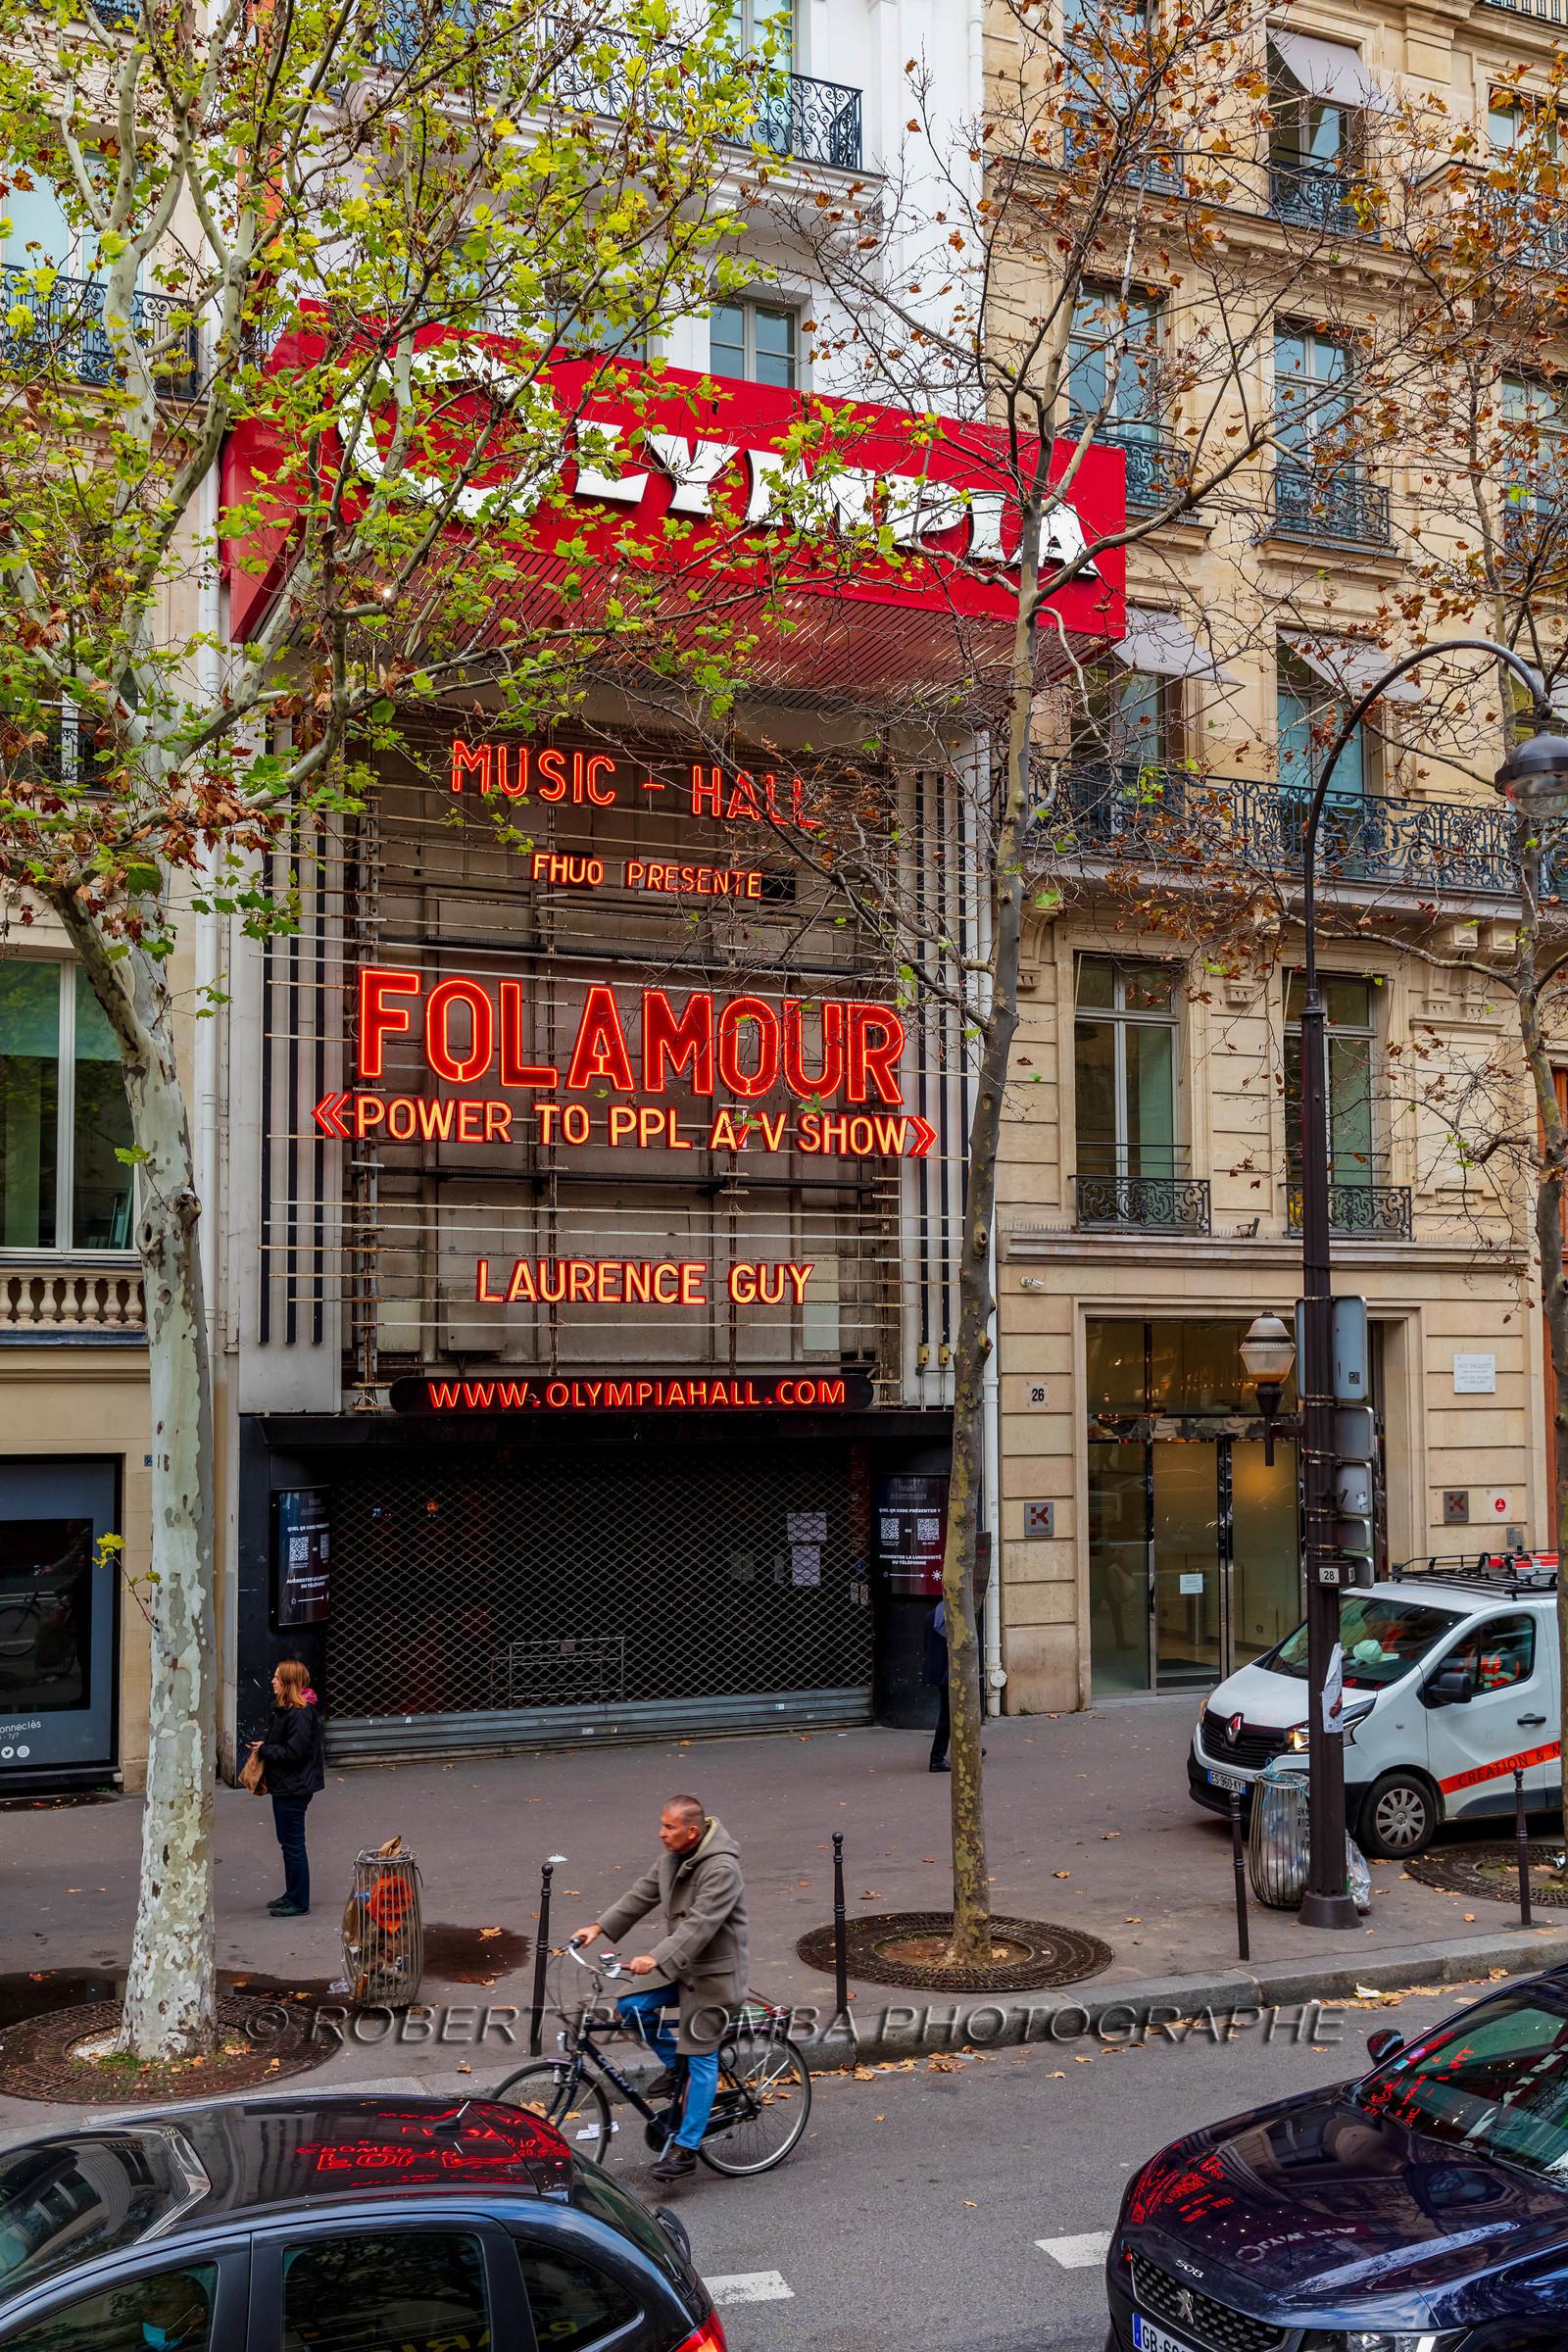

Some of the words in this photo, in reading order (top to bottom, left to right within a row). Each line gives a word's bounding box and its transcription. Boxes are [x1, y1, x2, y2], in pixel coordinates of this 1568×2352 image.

[451, 738, 617, 808] MUSIC
[690, 763, 821, 830] HALL
[531, 853, 605, 886] FHUO
[625, 859, 763, 899] PRESENTE
[357, 967, 906, 1104] FOLAMOUR
[532, 1102, 590, 1147] TO
[608, 1104, 694, 1151] PPL
[476, 1258, 708, 1305] LAURENCE
[729, 1261, 814, 1305] GUY
[427, 1379, 846, 1409] WWW.OLYMPIAHALL.COM
[1032, 1388, 1045, 1401] 26
[1323, 1570, 1335, 1581] 28
[1458, 1753, 1529, 1787] CREATION
[1175, 2259, 1204, 2278] 508
